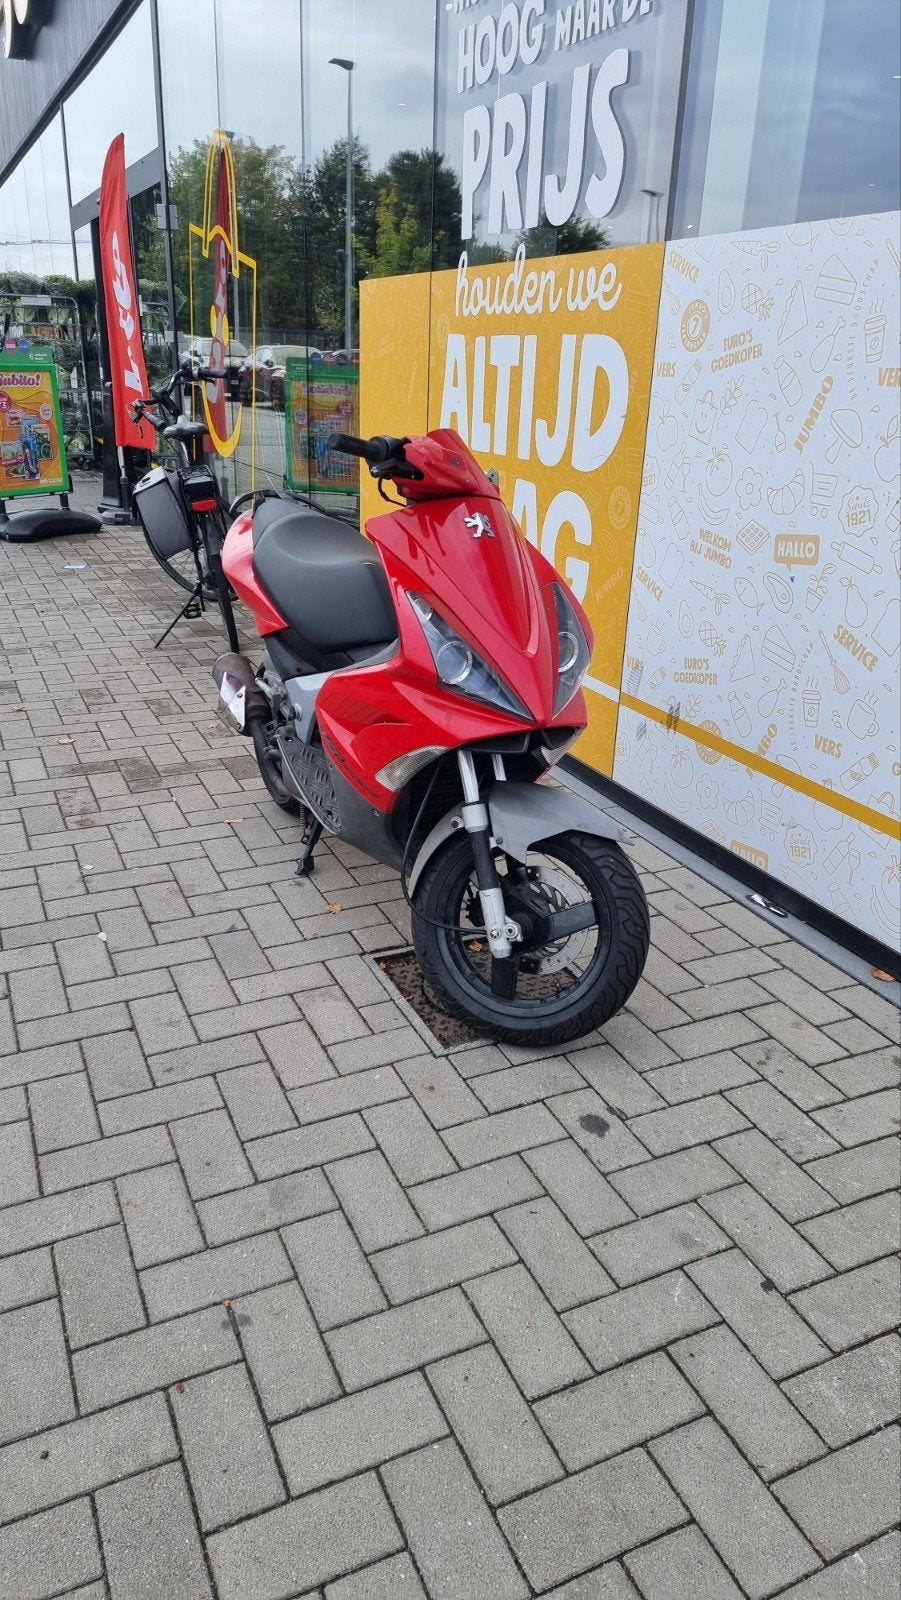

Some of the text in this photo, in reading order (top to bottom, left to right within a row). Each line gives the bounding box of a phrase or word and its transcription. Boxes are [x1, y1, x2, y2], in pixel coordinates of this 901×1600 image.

[457, 0, 546, 93] HOOG
[554, 0, 616, 50] MAAR
[461, 49, 629, 240] PRIJS
[456, 243, 622, 317] houden we
[668, 251, 700, 284] SERVICE
[723, 329, 753, 352] EURO'S
[656, 361, 677, 378] VERS
[711, 343, 763, 373] GOEDKOPER
[440, 334, 629, 472] ALTIJD
[794, 376, 834, 455] JUMBO
[846, 509, 871, 527] 1921
[690, 539, 732, 569] BIJ JUMBO
[700, 527, 732, 552] WELKOM
[777, 541, 816, 558] HALLO
[635, 566, 664, 601] SERVICE
[833, 624, 879, 672] SERVICE
[674, 671, 718, 686] GOEDKOPER
[684, 657, 710, 670] EURO'S
[746, 724, 777, 781] JBO
[814, 733, 843, 759] VERS
[790, 845, 812, 859] 1921
